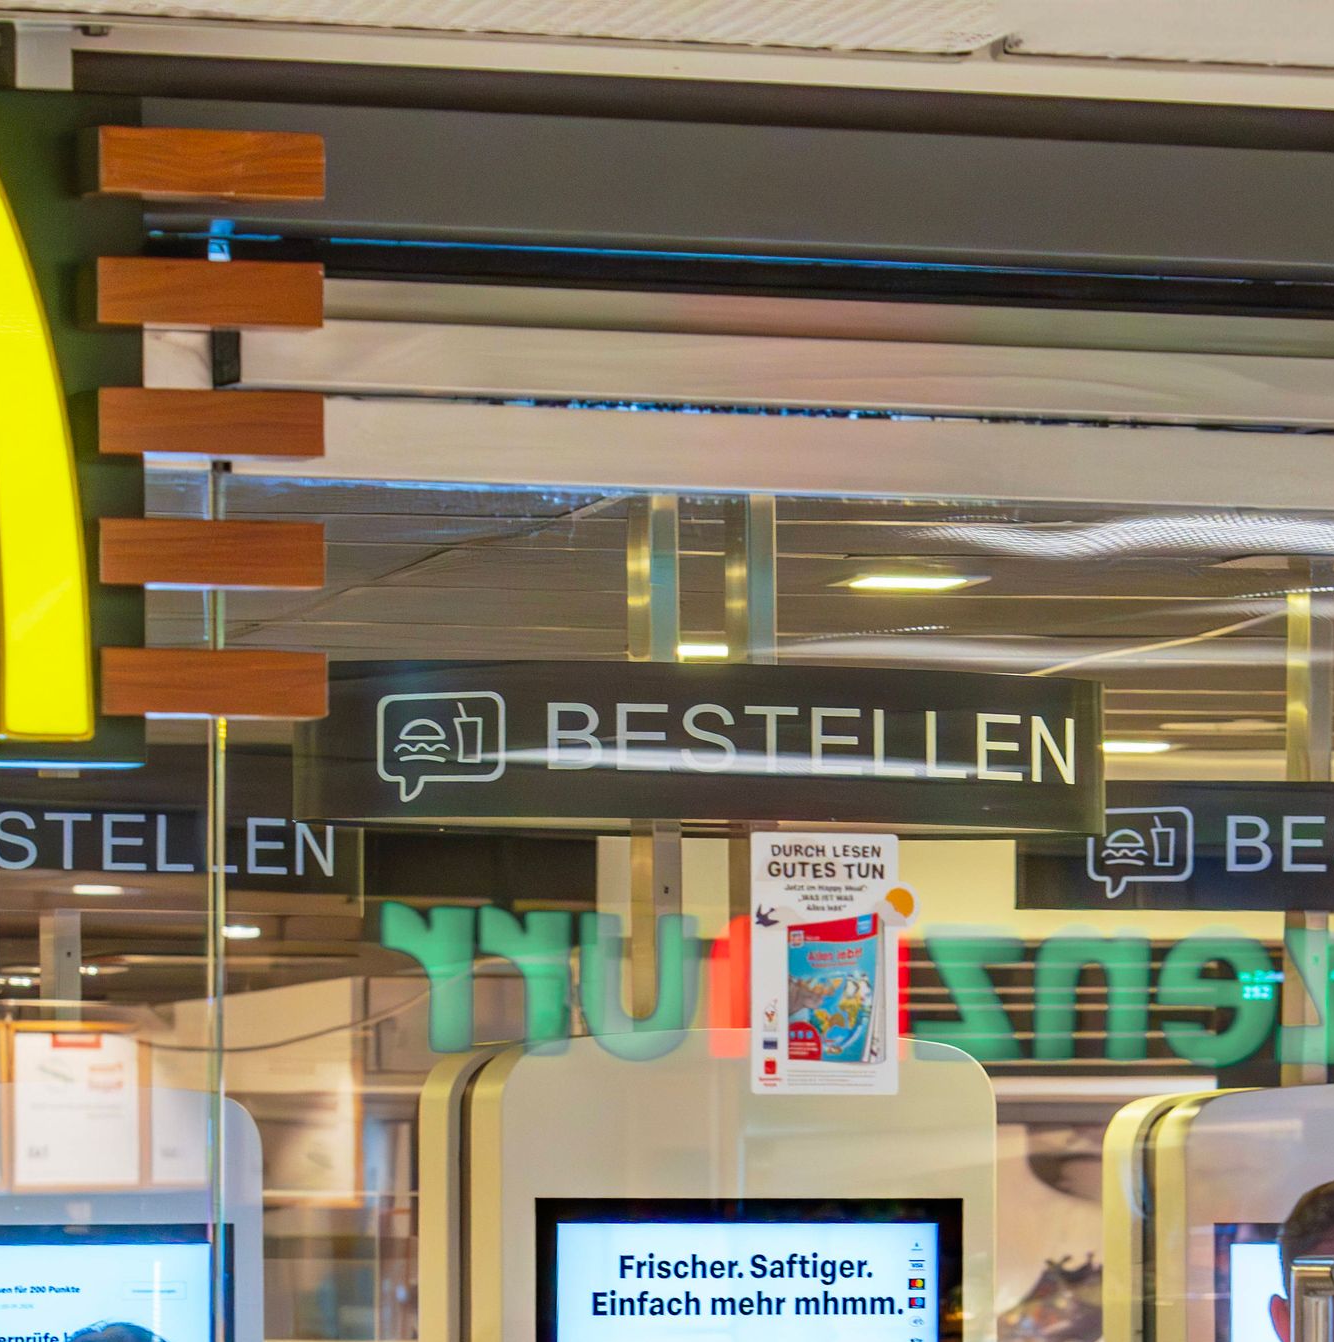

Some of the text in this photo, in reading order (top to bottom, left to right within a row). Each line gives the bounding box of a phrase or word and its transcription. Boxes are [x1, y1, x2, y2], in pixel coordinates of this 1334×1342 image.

[545, 702, 1076, 785] BESTELLEN
[770, 844, 882, 859] DURCH LESEN
[767, 860, 885, 881] GUTES TUN
[619, 1253, 873, 1286] Frischer. Saftiger.
[48, 1286, 81, 1294] Punkte
[591, 1290, 904, 1316] Einfach mehr mhmm.
